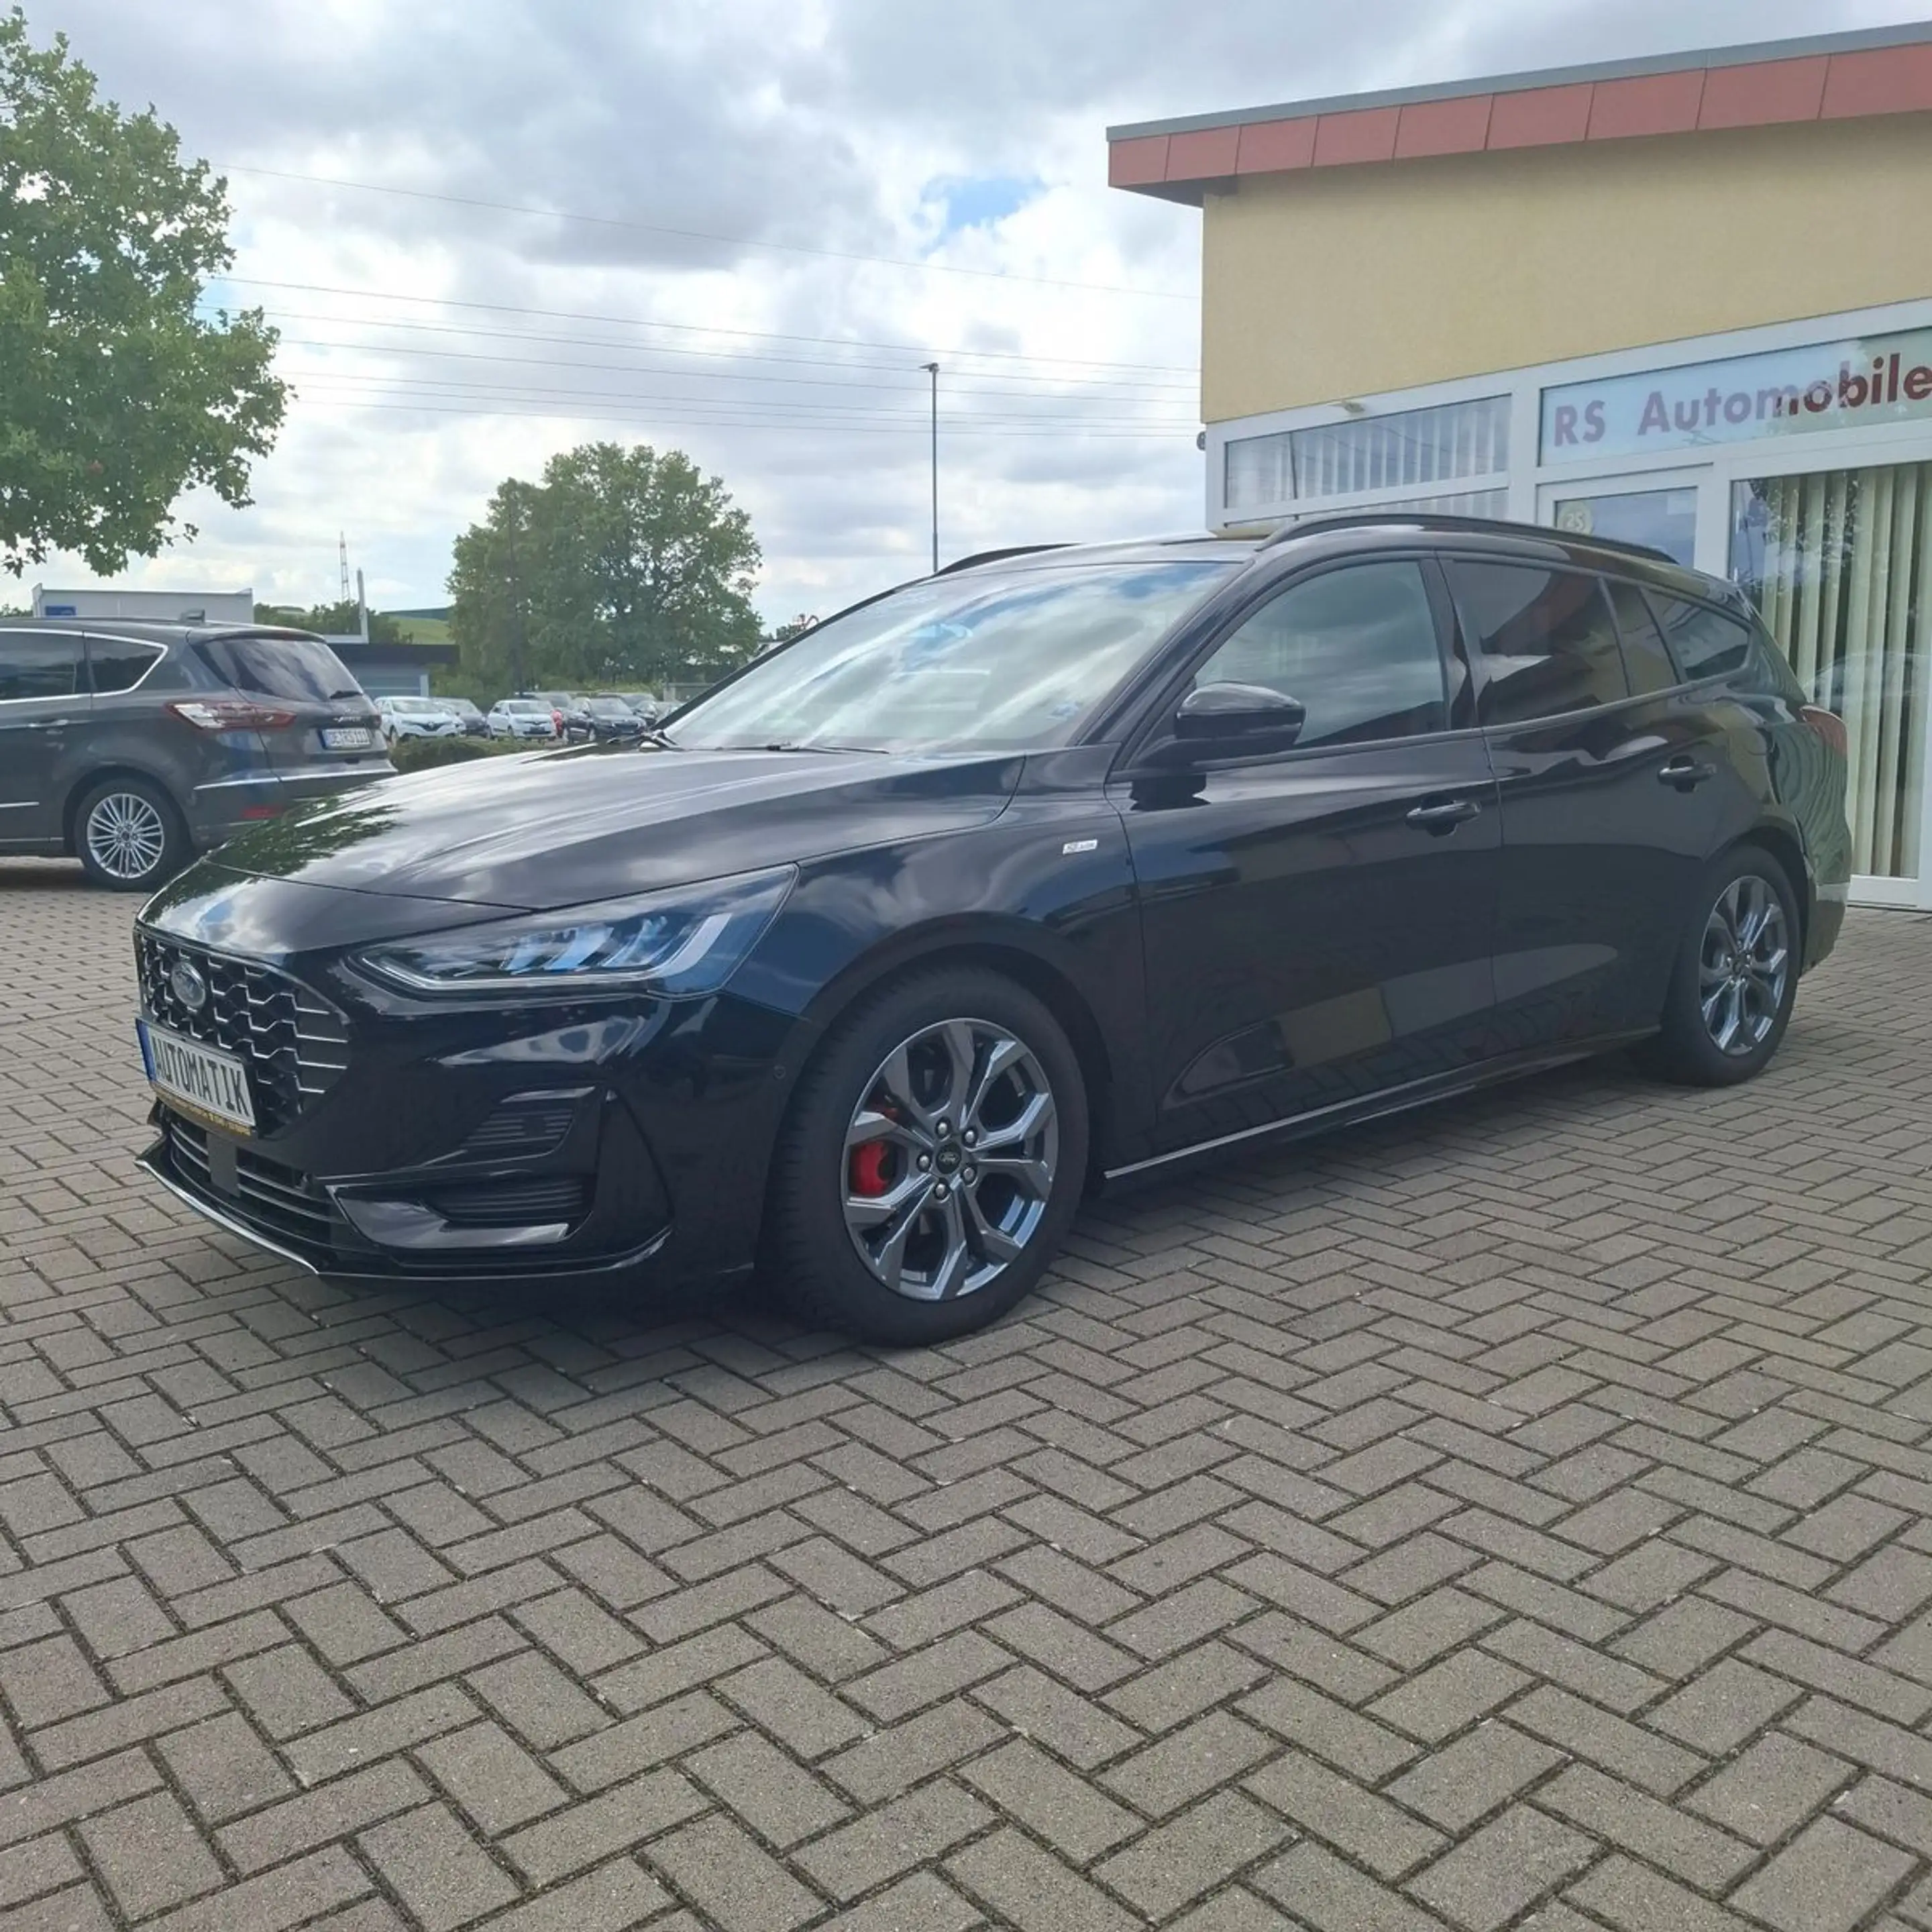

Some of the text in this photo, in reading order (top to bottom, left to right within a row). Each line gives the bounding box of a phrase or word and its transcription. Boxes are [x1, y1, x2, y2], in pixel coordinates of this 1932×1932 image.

[1553, 353, 1932, 447] RS Automobile
[151, 1034, 251, 1117] AUTOMATIK
